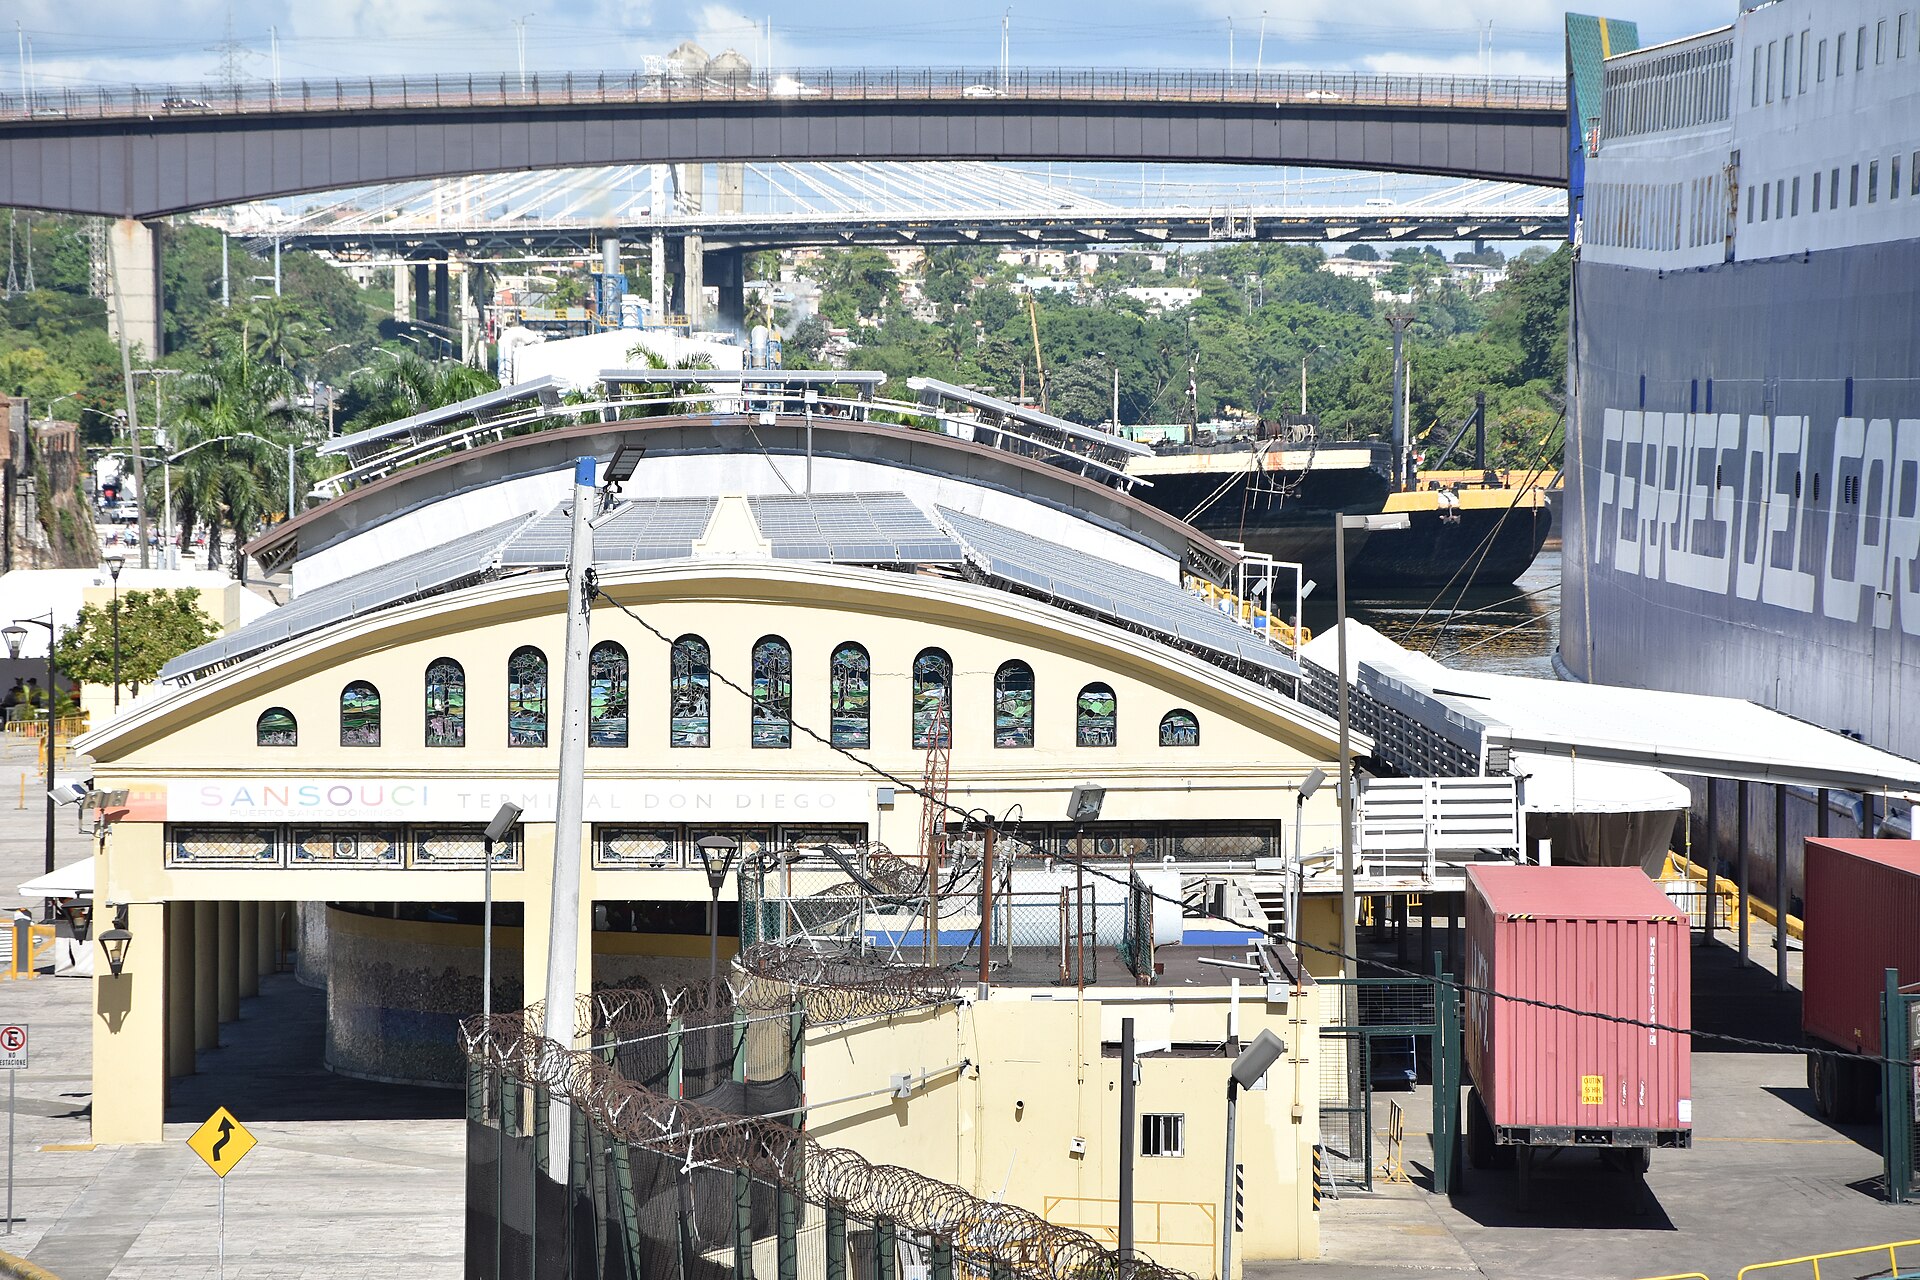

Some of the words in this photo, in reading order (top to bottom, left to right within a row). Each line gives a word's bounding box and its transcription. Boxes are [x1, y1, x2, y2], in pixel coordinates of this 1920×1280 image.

[1595, 408, 1740, 595] FERRIES
[1735, 414, 1815, 613] DEL
[200, 785, 428, 807] SANSOUCI
[457, 793, 622, 809] TERMIAL
[645, 793, 712, 809] DON
[736, 793, 836, 809] DIEGO
[230, 809, 284, 817] PUERTO
[287, 809, 334, 817] SANTO
[337, 809, 404, 817] DOMINGO
[8, 1031, 18, 1046] E
